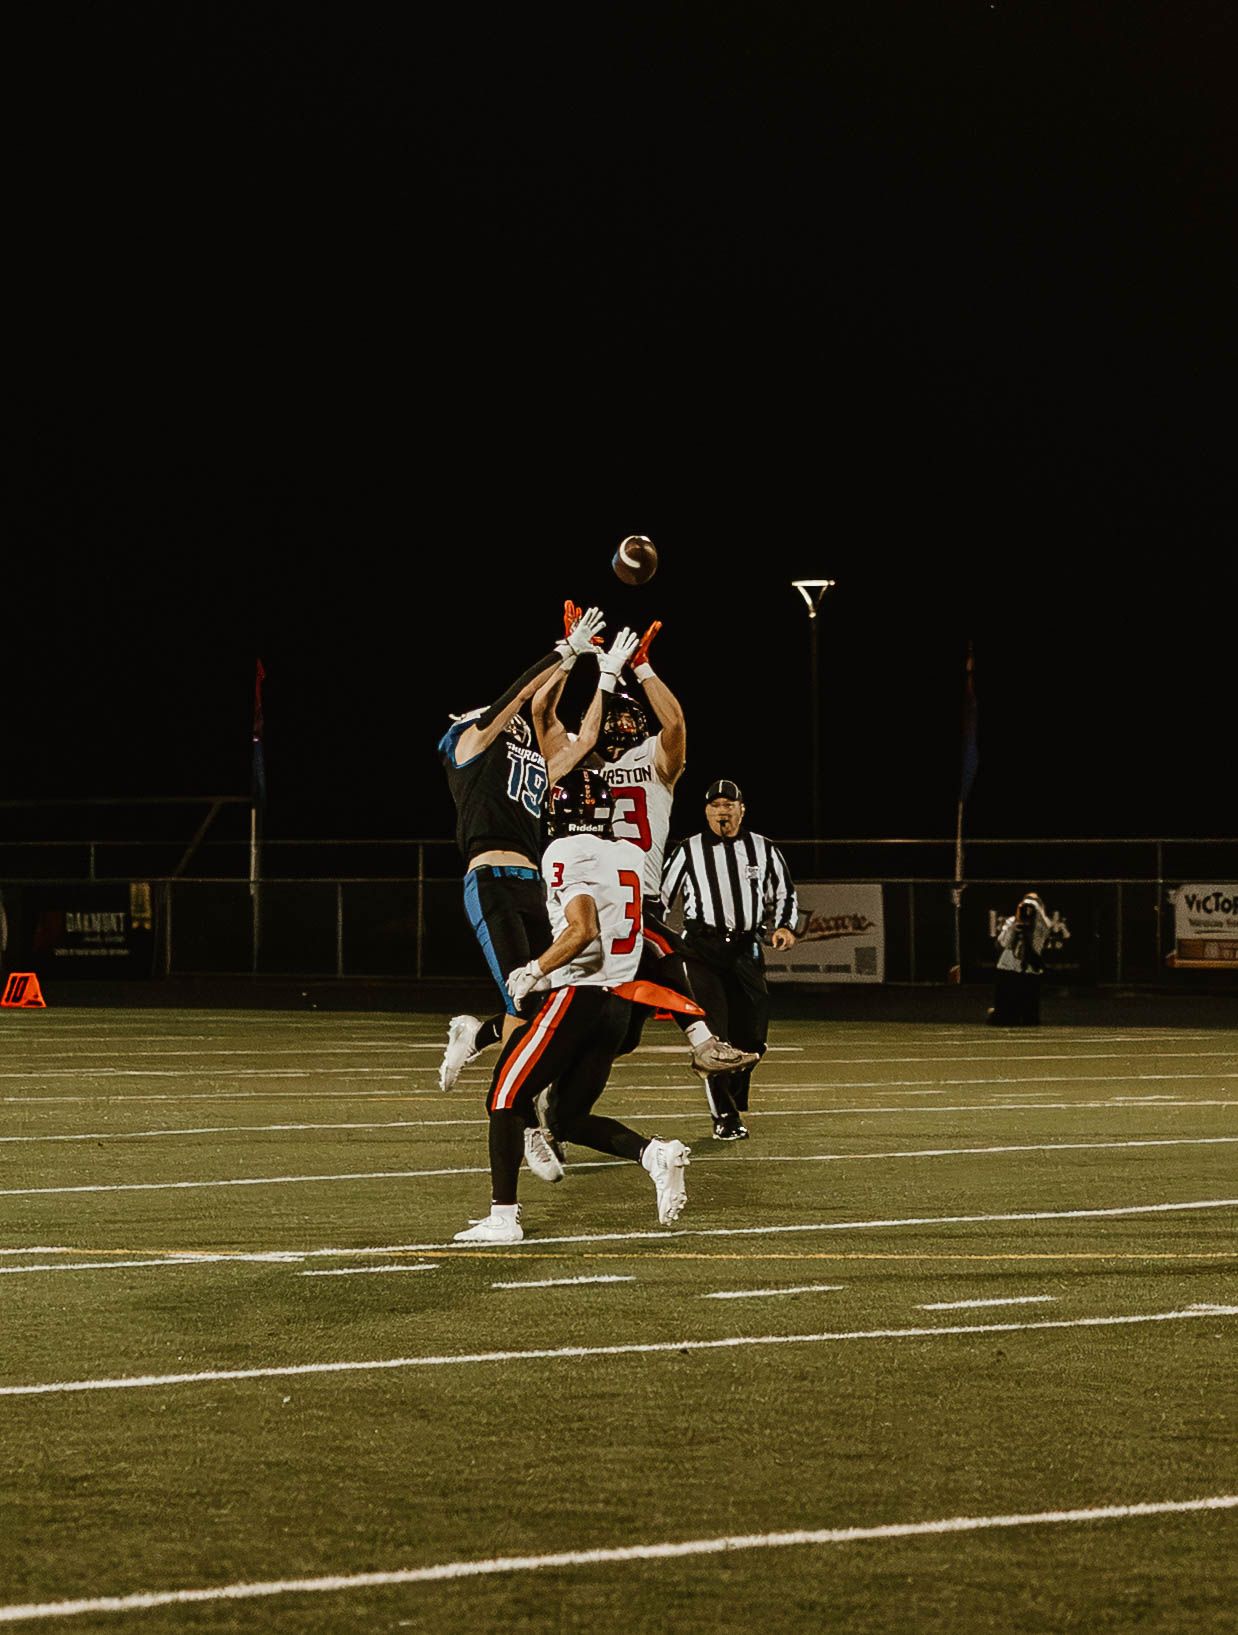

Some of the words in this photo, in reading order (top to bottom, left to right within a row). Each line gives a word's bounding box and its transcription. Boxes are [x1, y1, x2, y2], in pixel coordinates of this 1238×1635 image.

[507, 751, 549, 819] 19
[568, 823, 604, 832] Riddell
[551, 862, 564, 887] 3
[611, 870, 641, 954] 3
[5, 976, 29, 1002] 10
